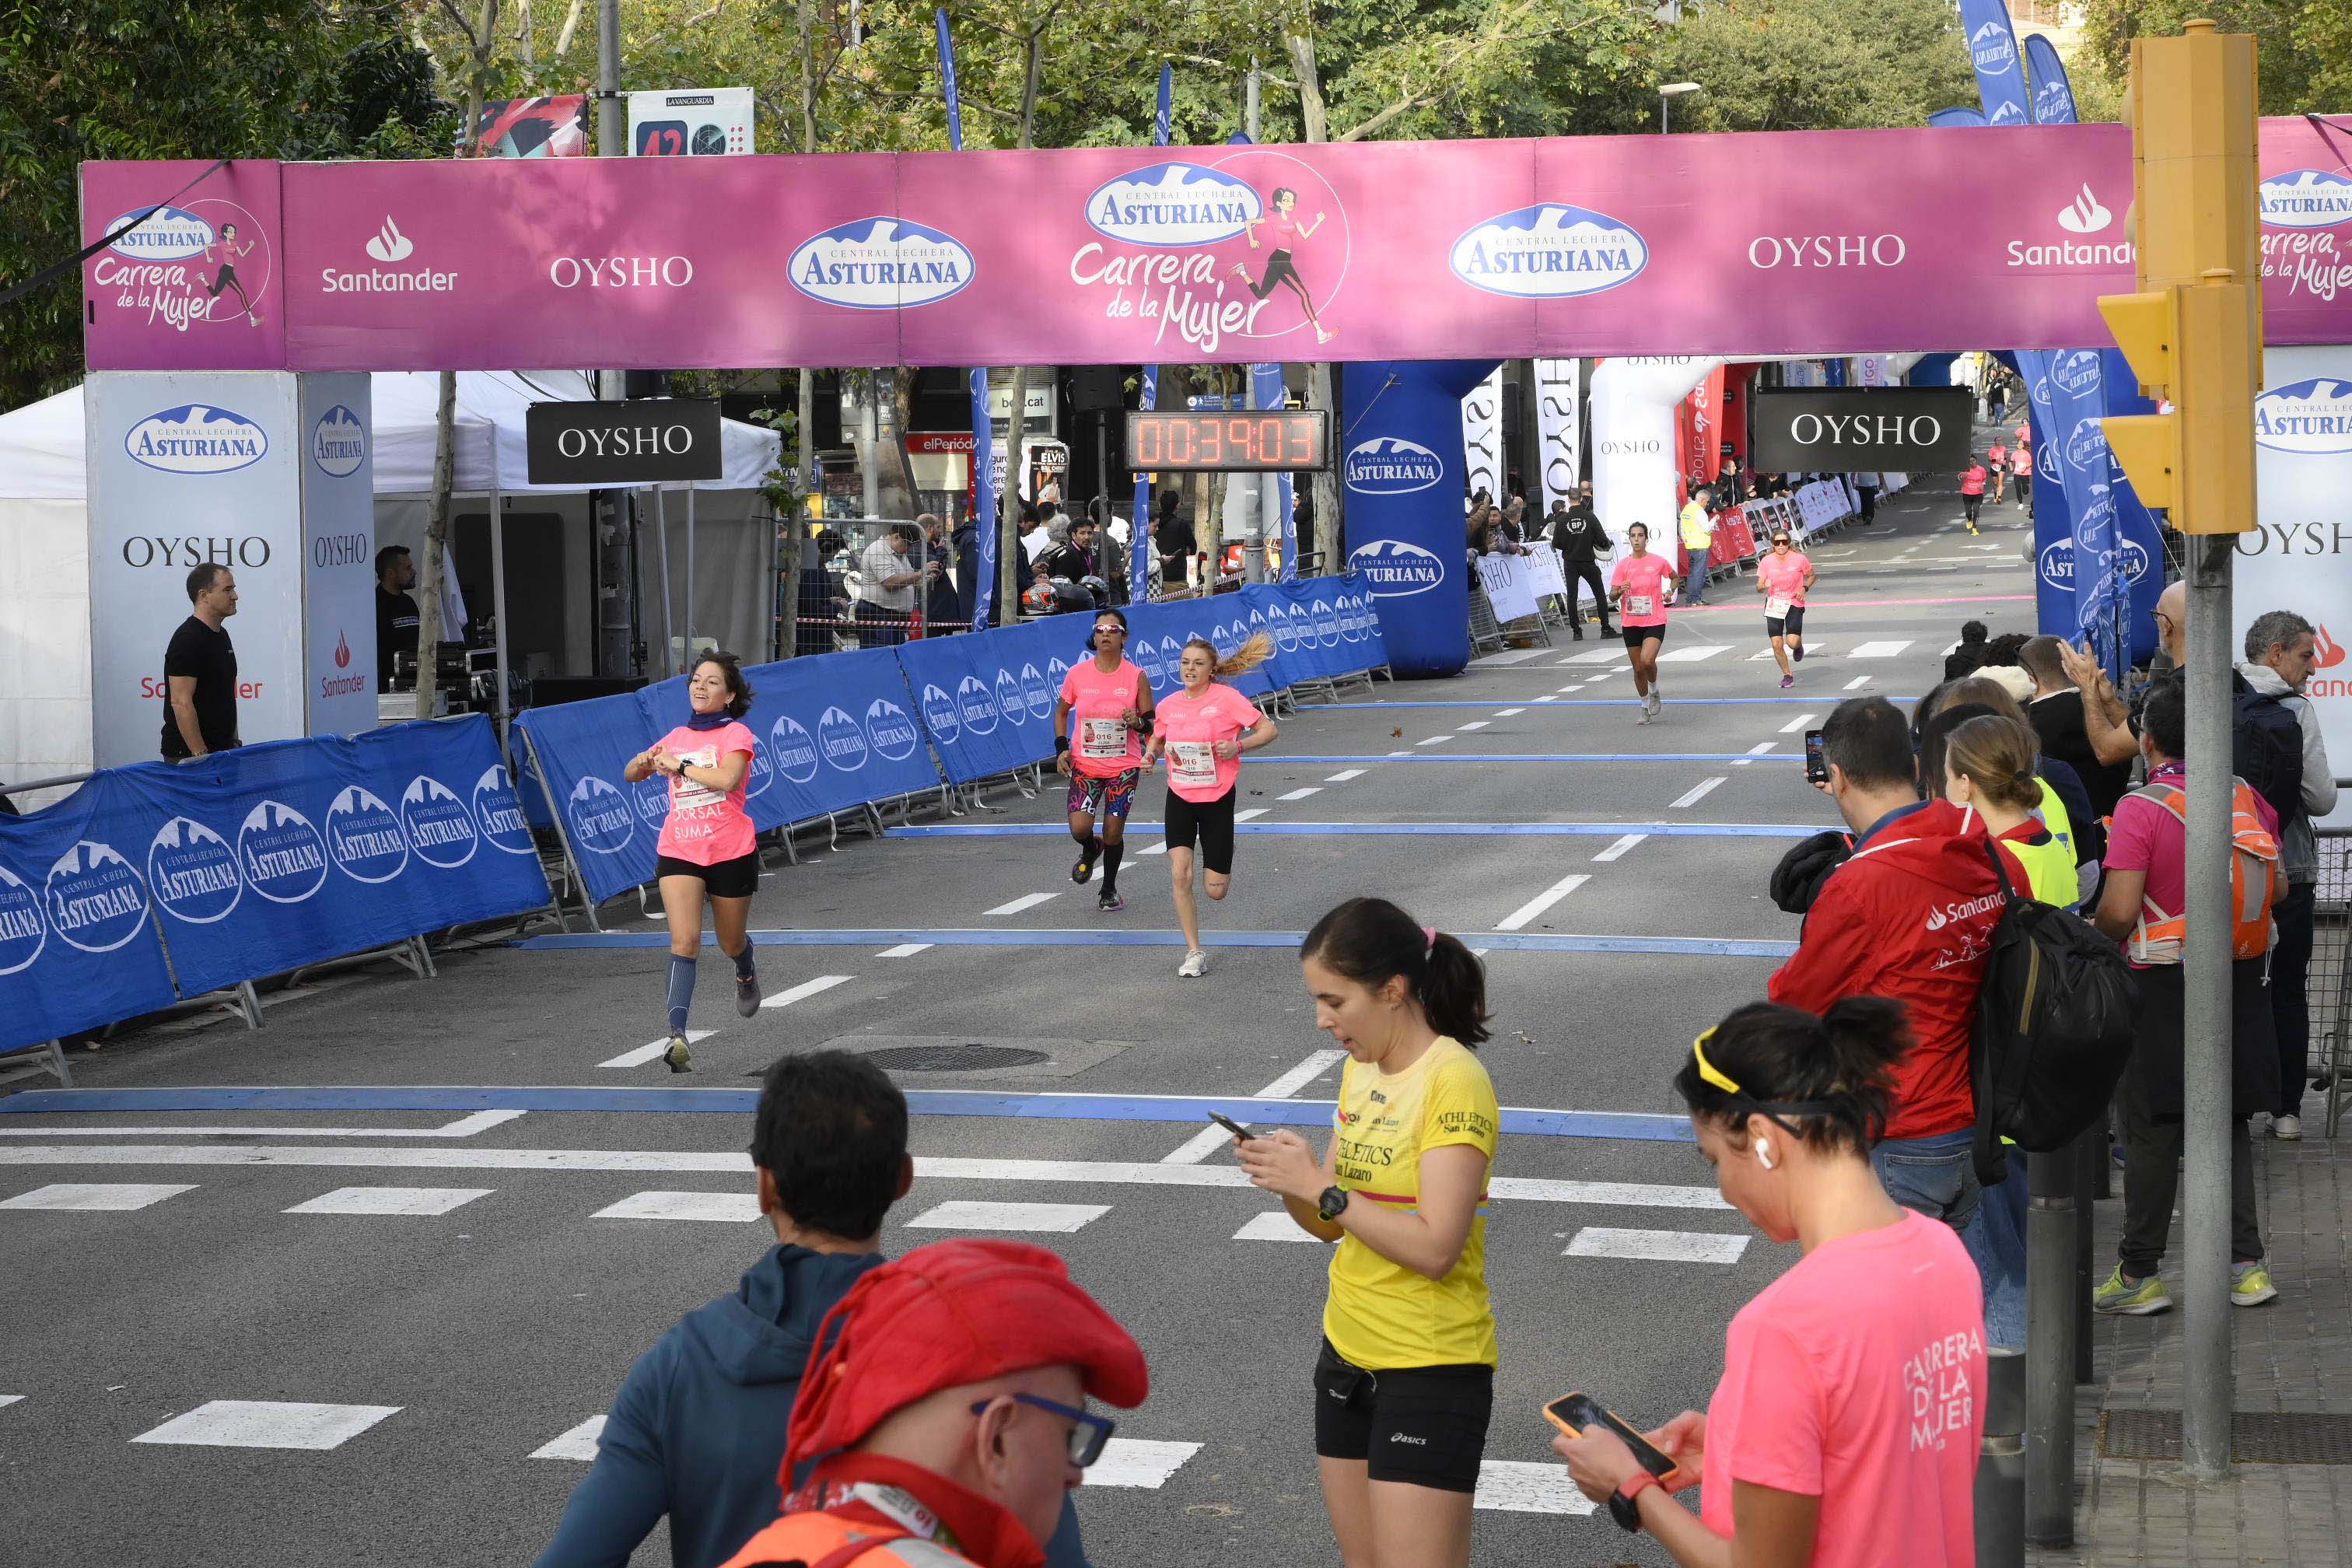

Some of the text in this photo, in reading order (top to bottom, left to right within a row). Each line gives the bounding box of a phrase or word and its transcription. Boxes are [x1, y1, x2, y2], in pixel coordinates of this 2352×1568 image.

[1125, 190, 1244, 200] CENTRAL LECHERA
[1098, 194, 1250, 226] ASTURIANA
[831, 248, 954, 258] CENTRAL LECHERA
[1495, 235, 1626, 246] CENTRAL LECHERA
[1748, 234, 1906, 268] OYSHO
[2007, 239, 2137, 266] Santand
[2260, 233, 2335, 255] arrera
[802, 251, 961, 285] ASTURIANA
[1070, 242, 1216, 285] Carrera
[1465, 240, 1633, 274] ASTURIANA
[2278, 255, 2293, 277] la
[94, 257, 187, 287] Carrera
[322, 267, 458, 293] Santander
[550, 256, 693, 288] OYSHO
[117, 283, 221, 332] de la Mujer
[1105, 279, 1271, 353] de la Mujer
[1002, 396, 1044, 408] b.cat
[2277, 404, 2329, 413] CENTRAL
[136, 430, 258, 457] ASTURIANA
[558, 425, 693, 457] OYSHO
[923, 437, 973, 450] elPeriód
[1138, 418, 1314, 464] 00:39:03
[1791, 414, 1941, 446] OYSHO
[317, 432, 362, 460] ASTURIANA
[1041, 452, 1065, 464] ELVIS
[1601, 439, 1660, 455] OYSHO
[1348, 460, 1436, 482] ASTURIANA
[122, 536, 271, 569] OYSHO
[314, 533, 367, 569] OYSHO
[1352, 561, 1437, 583] ATURIANA
[321, 674, 366, 698] Santander
[775, 742, 816, 768] ASTURIANA
[823, 731, 866, 758] ASTURIANA
[487, 796, 513, 807] CENTRAL
[341, 818, 367, 831] CENTRAL
[408, 813, 474, 849] ASTURIANA
[674, 823, 713, 840] SUMA
[254, 829, 313, 849] CENTRAL LECHERA
[334, 824, 405, 863] ASTURIANA
[166, 847, 226, 867] CENTRAL LECHERA
[247, 842, 324, 883] ASTURIANA
[63, 877, 96, 894] CENTRAL
[157, 861, 239, 902] ASTURIANA
[1438, 1111, 1493, 1135] ATHLETICS
[1444, 1123, 1461, 1133] San
[1336, 1137, 1394, 1167] THLETICS
[1344, 1162, 1372, 1183] Lázaro
[1939, 1365, 1970, 1401] LA
[1910, 1395, 1973, 1452] MJER
